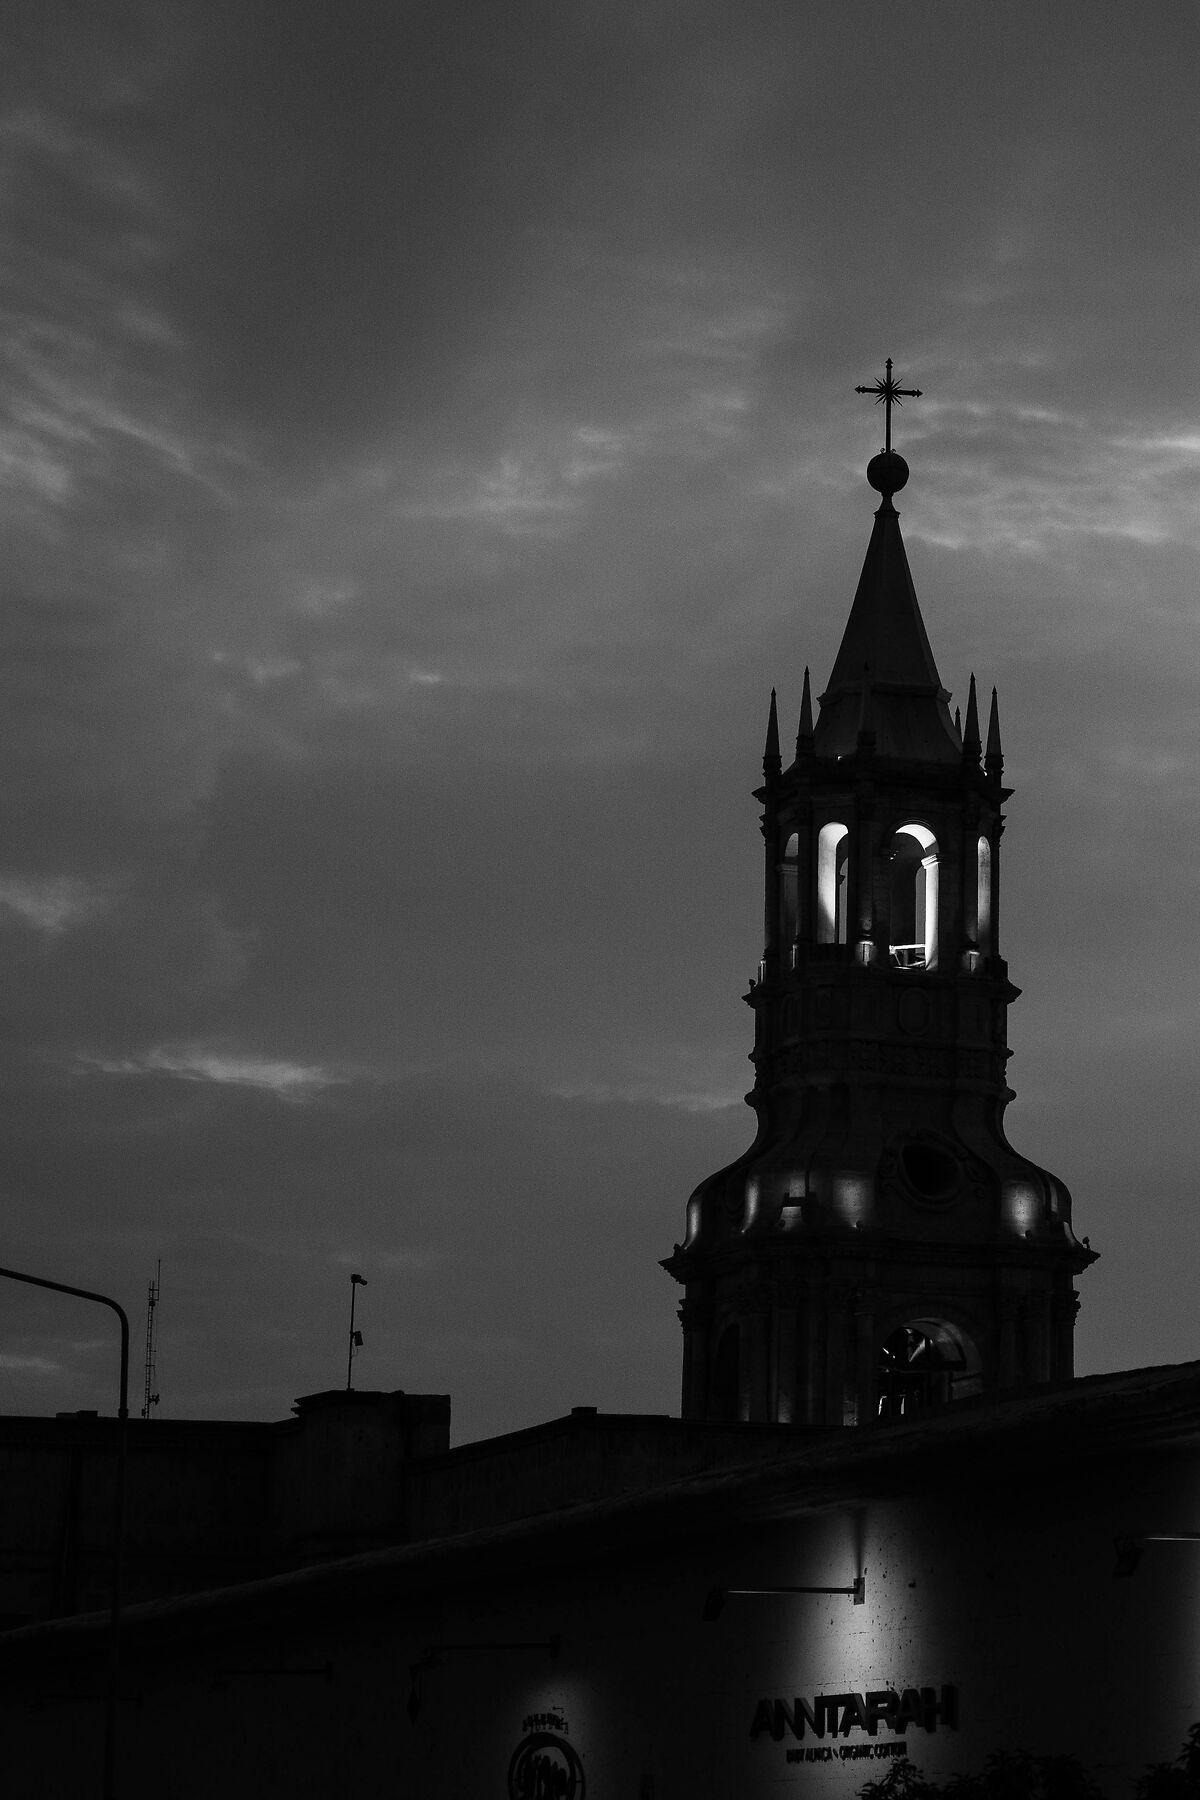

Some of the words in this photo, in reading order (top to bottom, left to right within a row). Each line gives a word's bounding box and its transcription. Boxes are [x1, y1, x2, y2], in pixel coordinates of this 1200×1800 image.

[749, 1682, 959, 1740] ANNTARAH
[839, 1744, 873, 1760] ORGANIC
[875, 1741, 907, 1758] COTTON
